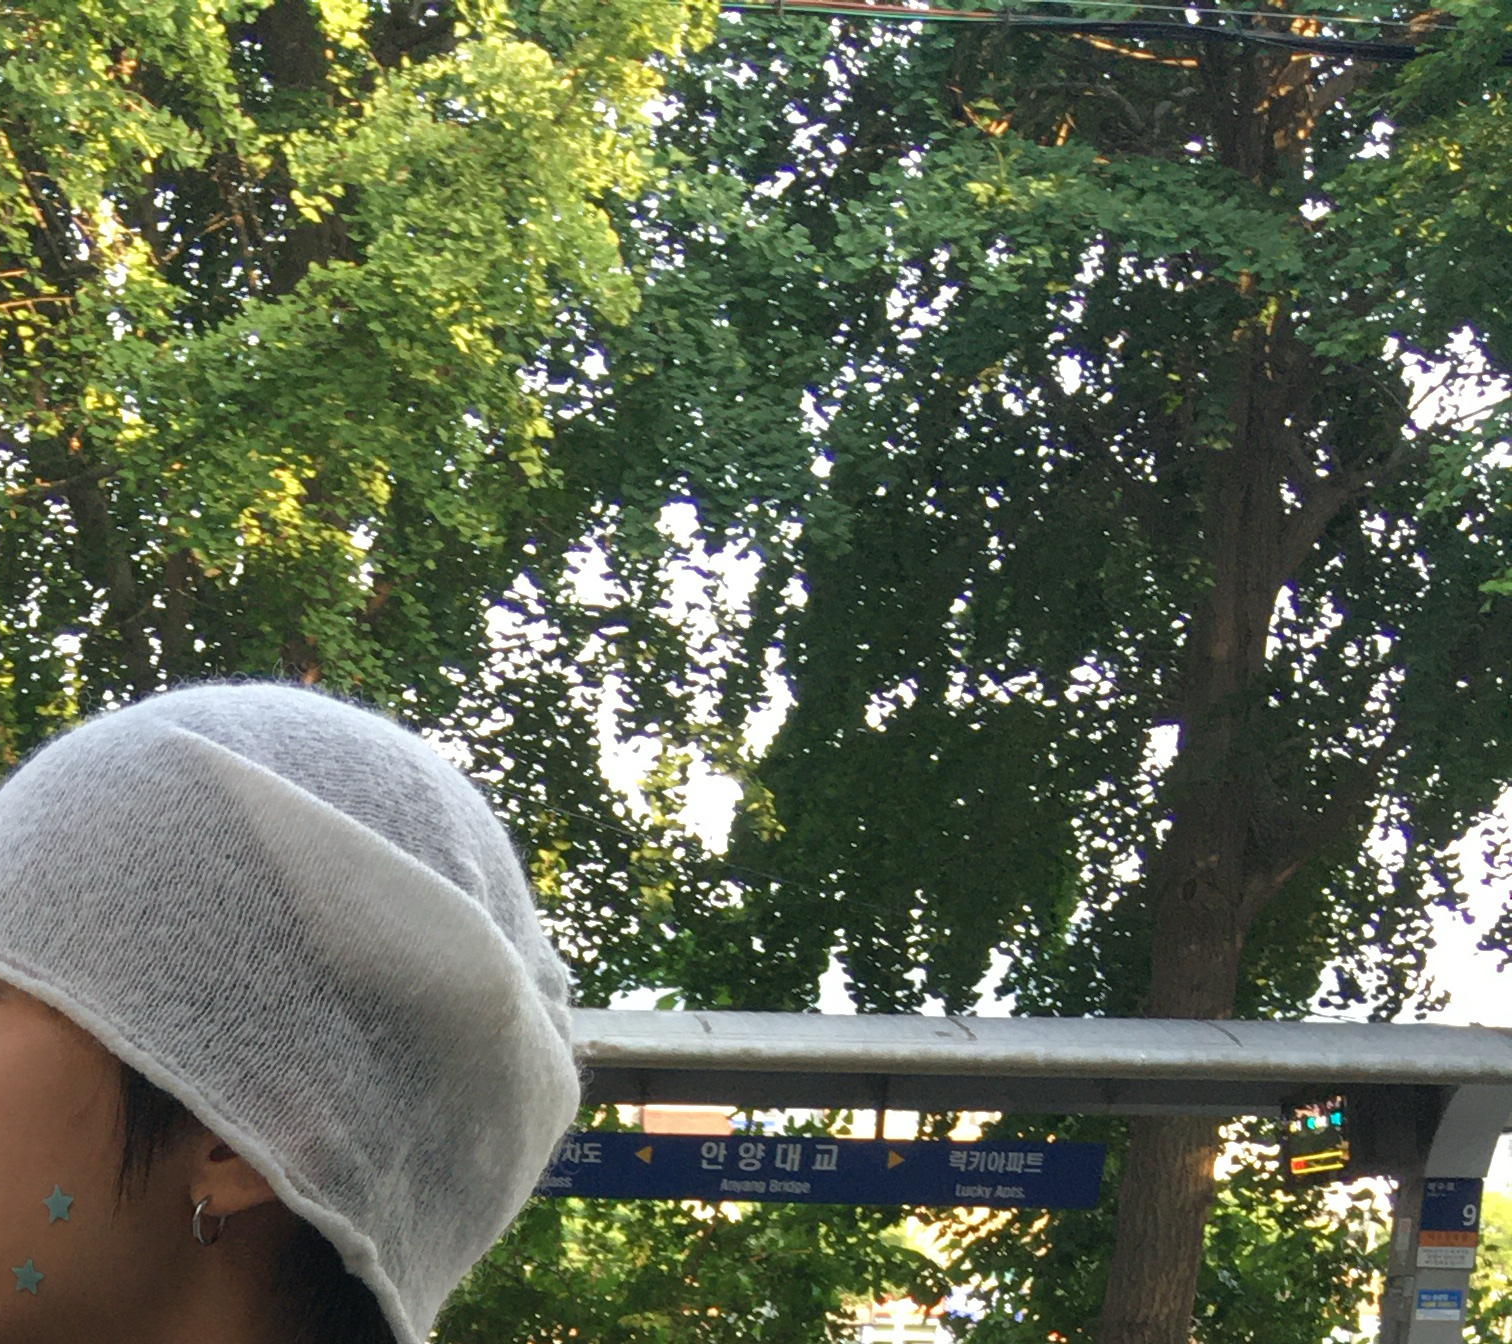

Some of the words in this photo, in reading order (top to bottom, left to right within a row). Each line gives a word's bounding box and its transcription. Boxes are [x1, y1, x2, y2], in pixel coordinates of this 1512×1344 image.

[552, 1142, 603, 1165] 차도
[699, 1142, 839, 1172] 안양대교
[948, 1149, 1045, 1174] 럭키아파트
[1462, 1203, 1477, 1227] 9
